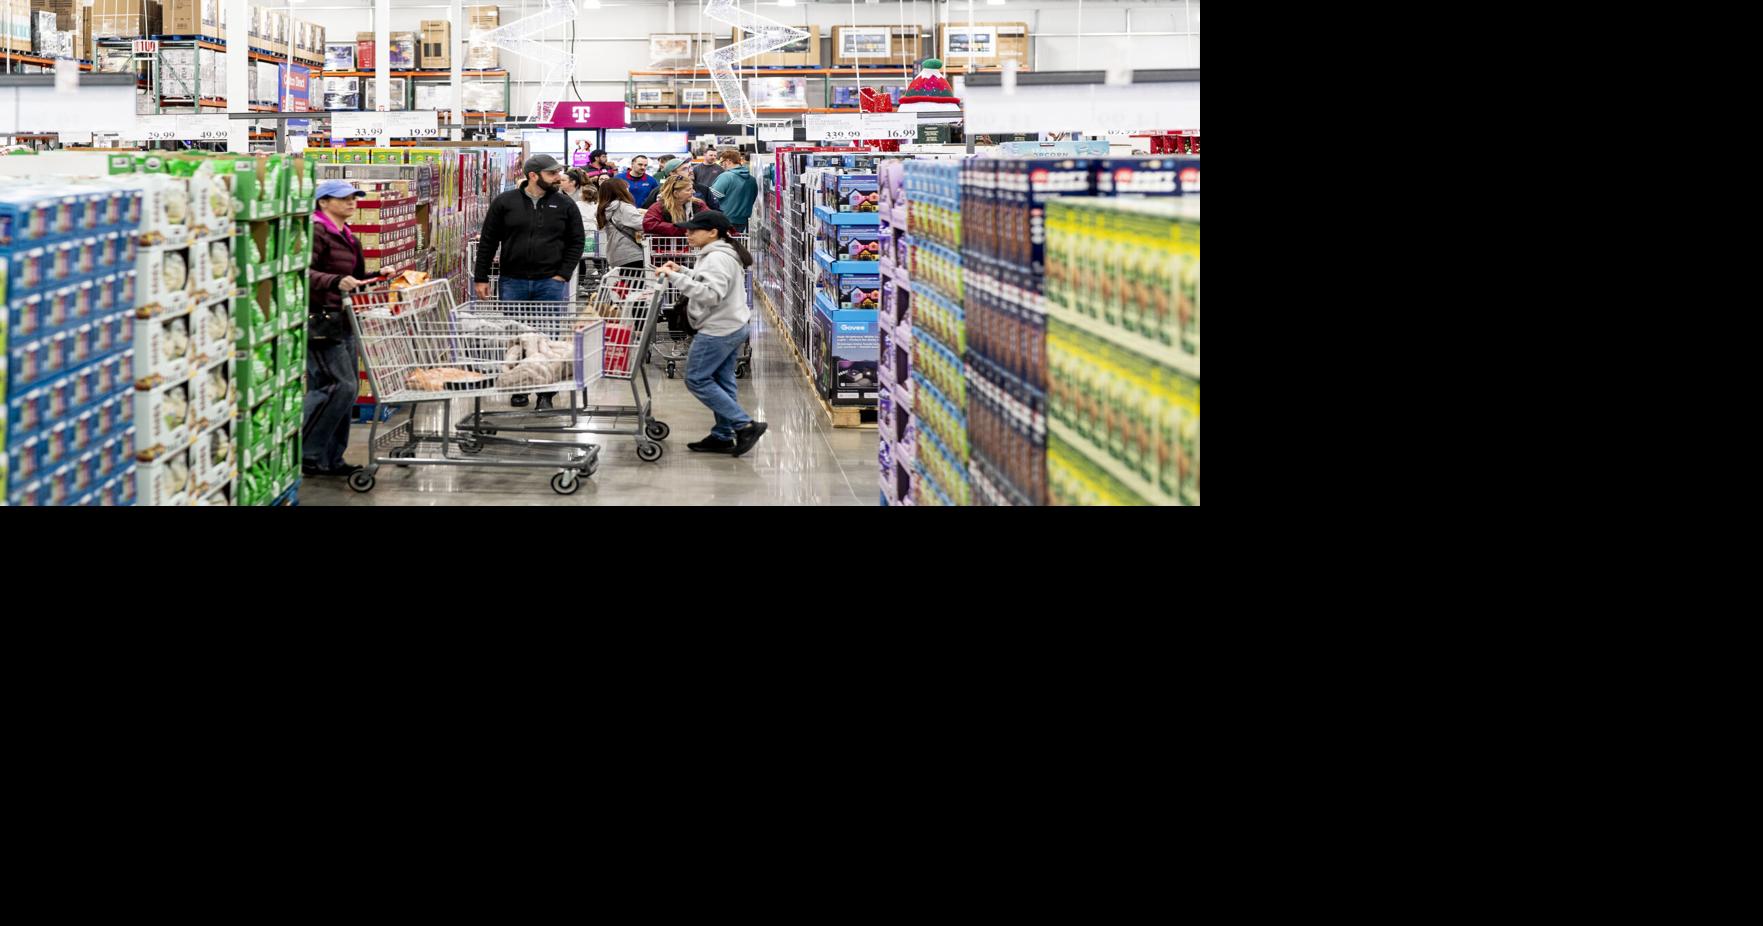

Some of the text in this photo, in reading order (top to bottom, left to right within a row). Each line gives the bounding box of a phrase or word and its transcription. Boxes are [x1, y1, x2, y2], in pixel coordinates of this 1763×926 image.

[571, 105, 591, 123] T
[148, 132, 175, 140] 29.99
[200, 131, 228, 139] 49.99
[354, 128, 383, 136] 33.99
[409, 128, 437, 136] 19.99
[825, 131, 861, 139] 339.99
[887, 129, 916, 138] 16.99
